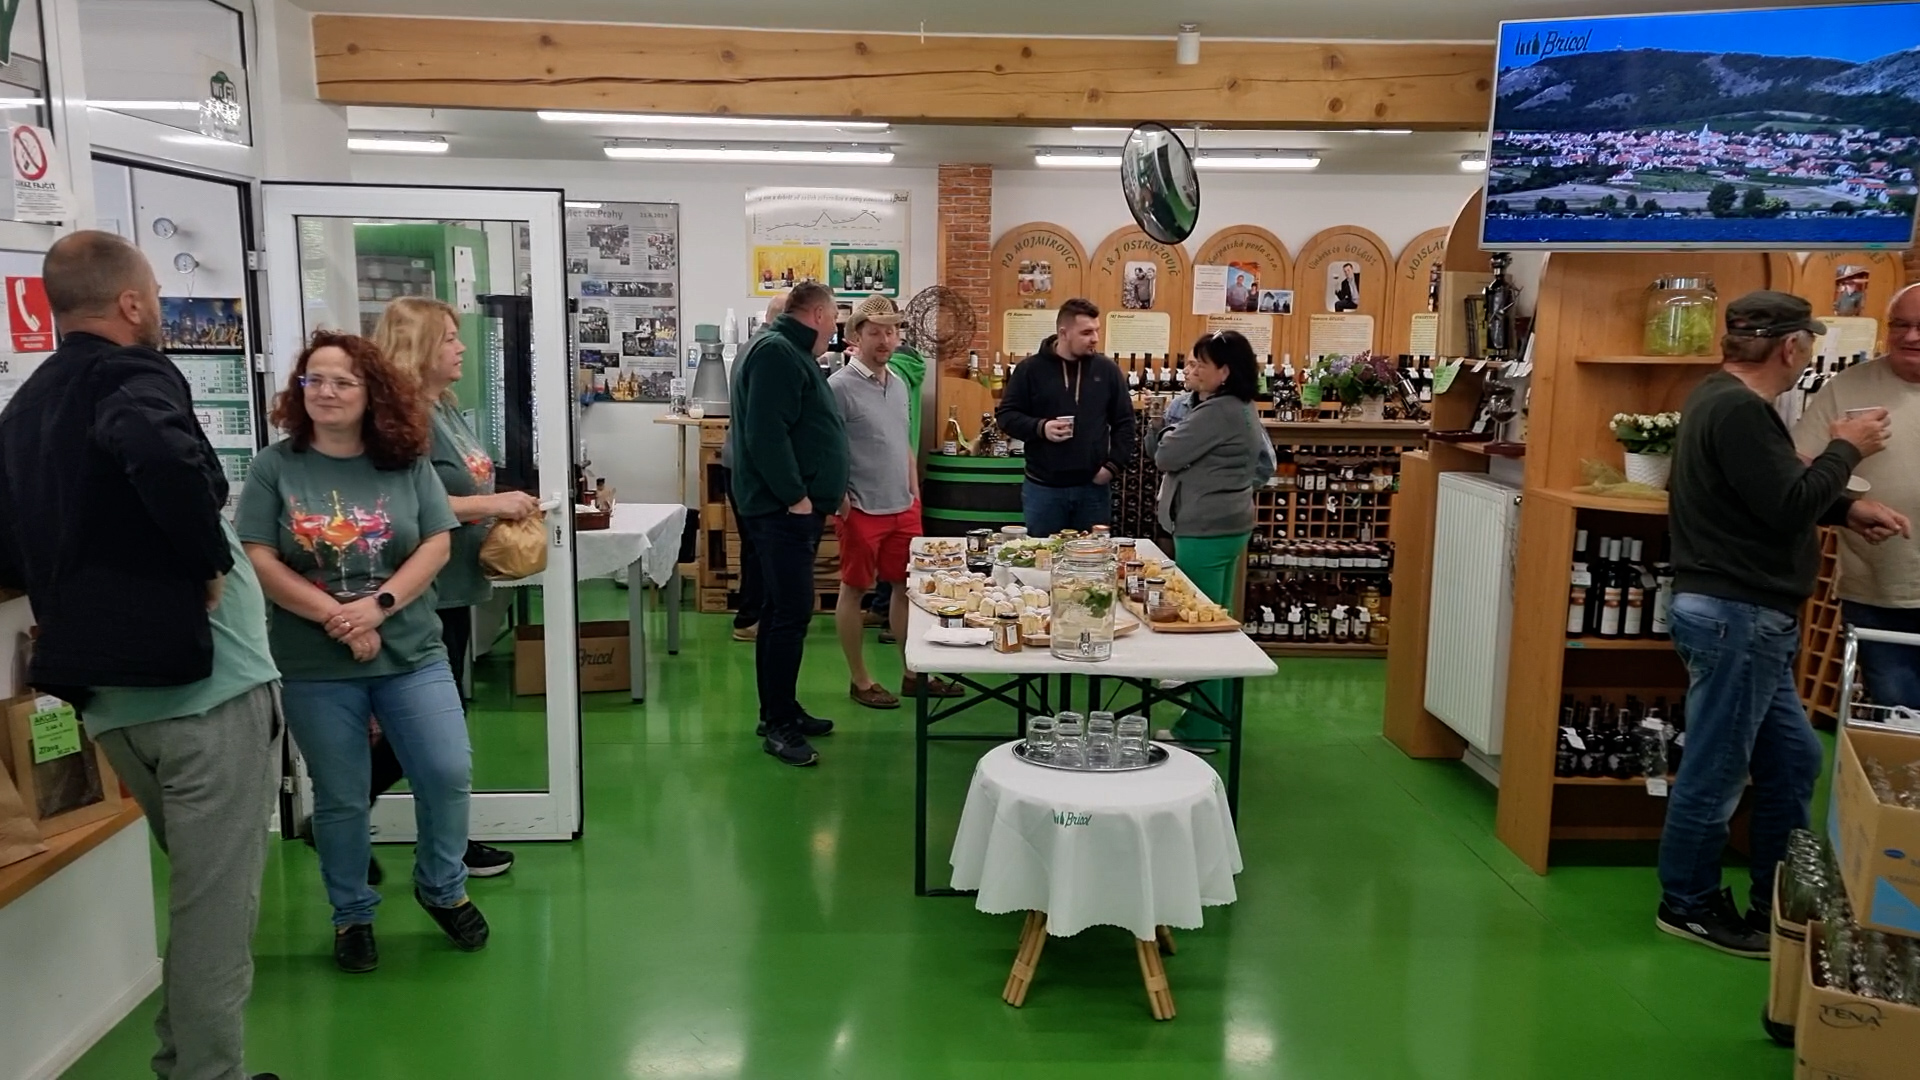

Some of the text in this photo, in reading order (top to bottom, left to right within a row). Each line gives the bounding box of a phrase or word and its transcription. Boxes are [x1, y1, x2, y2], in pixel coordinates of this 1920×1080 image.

[1540, 28, 1593, 59] Bricol
[597, 209, 624, 221] Prahy
[1002, 254, 1014, 269] PD
[1064, 811, 1092, 829] Bricol
[1819, 1003, 1881, 1028] TENA
